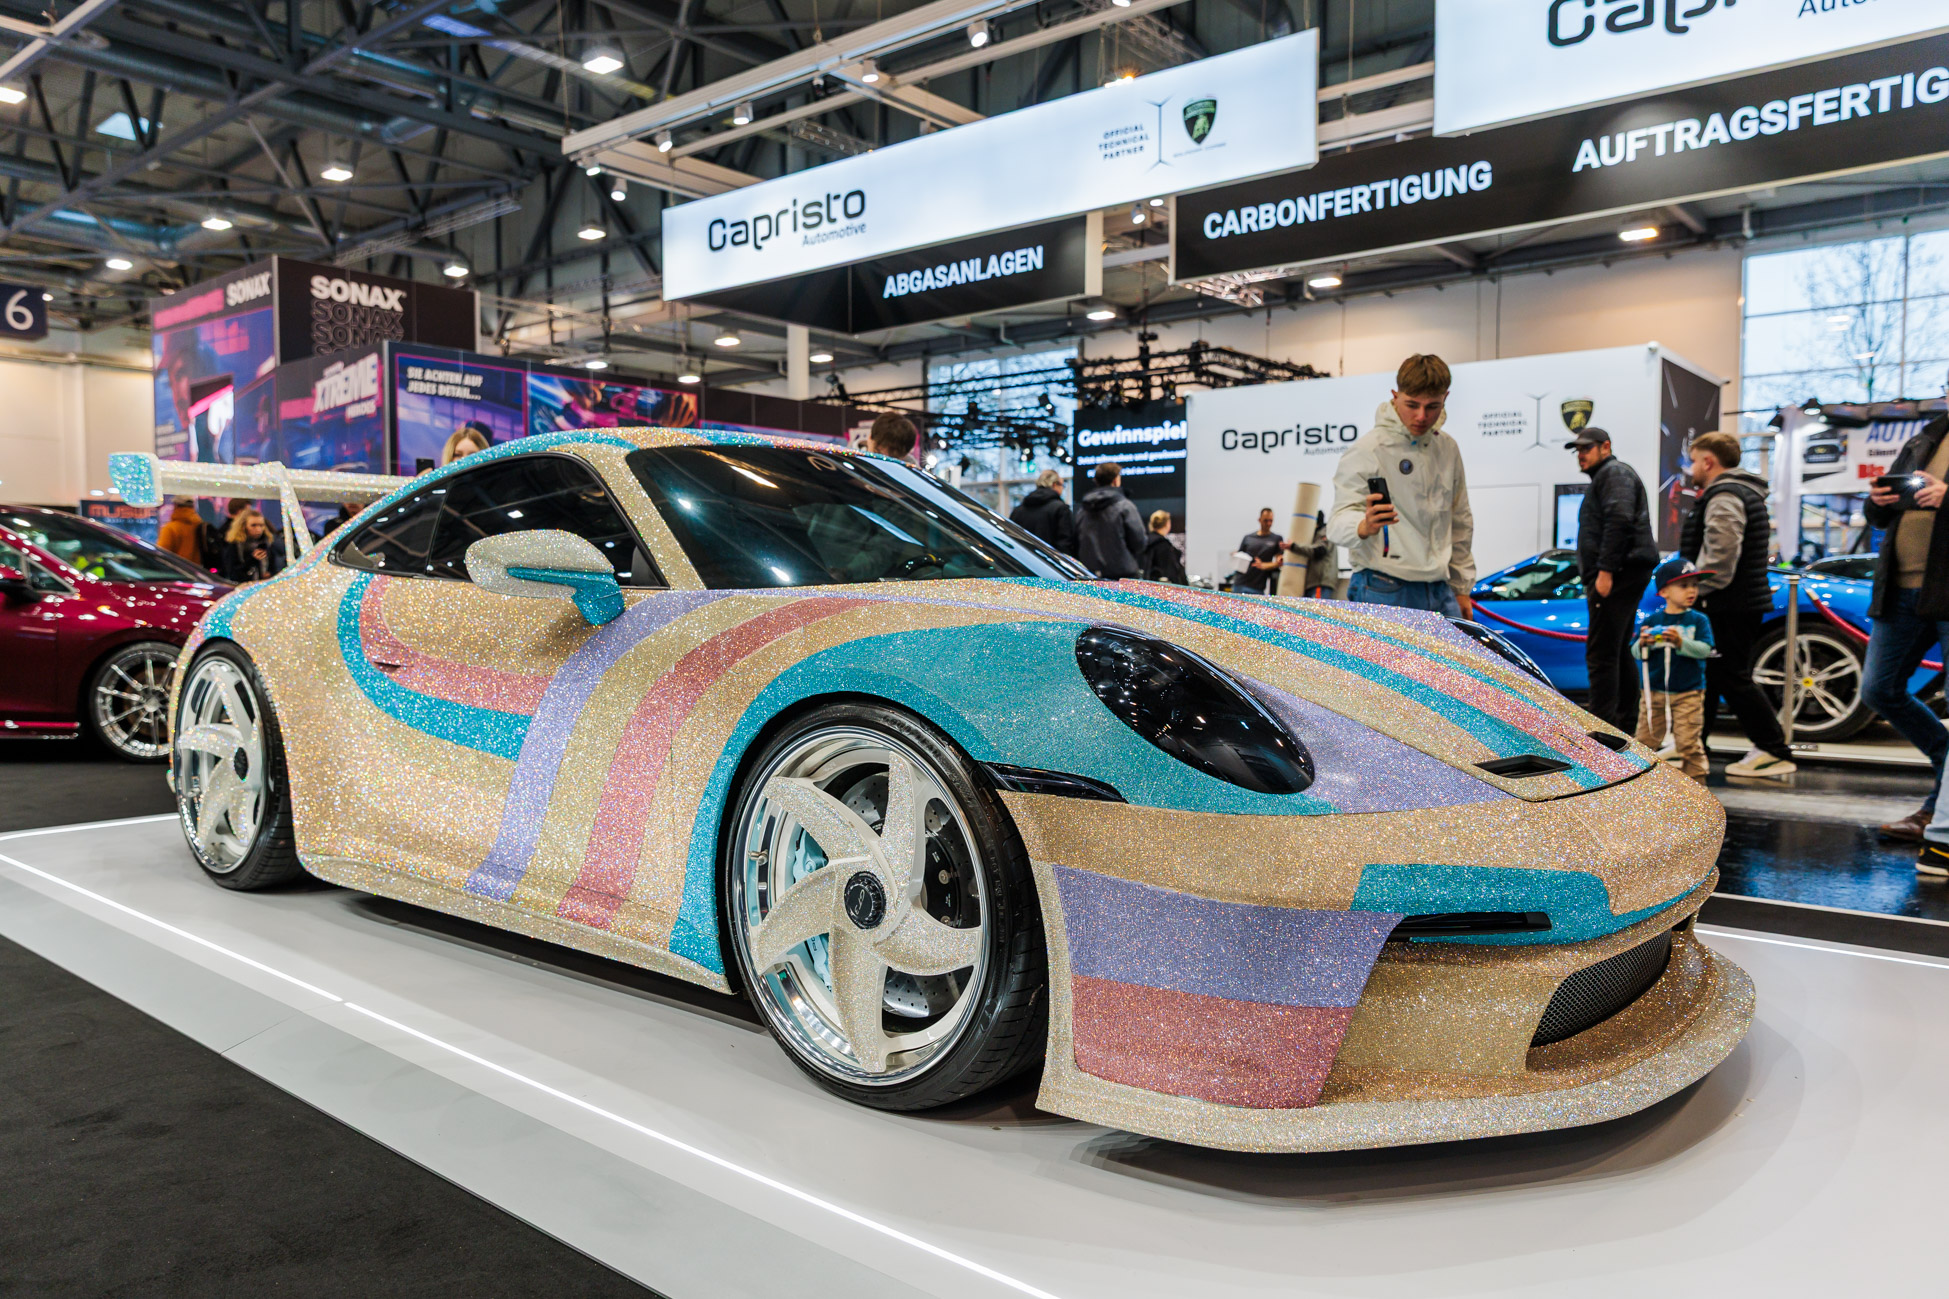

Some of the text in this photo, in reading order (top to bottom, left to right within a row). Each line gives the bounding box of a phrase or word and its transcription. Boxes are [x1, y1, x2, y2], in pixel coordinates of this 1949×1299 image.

[1098, 134, 1149, 151] TECHNICAL
[1103, 124, 1144, 140] OFFICIAL
[1103, 146, 1144, 160] PARTNER
[1203, 160, 1493, 240] CARBONFERTIGUNG
[708, 189, 865, 252] Capristo
[802, 222, 867, 247] Automotive
[882, 245, 1044, 299] ABGASANLAGEN
[227, 272, 272, 307] SONAX
[310, 275, 403, 313] SONAX
[5, 290, 34, 330] 6
[1078, 420, 1187, 447] Gewinnspiel
[1222, 423, 1357, 454] Capristo
